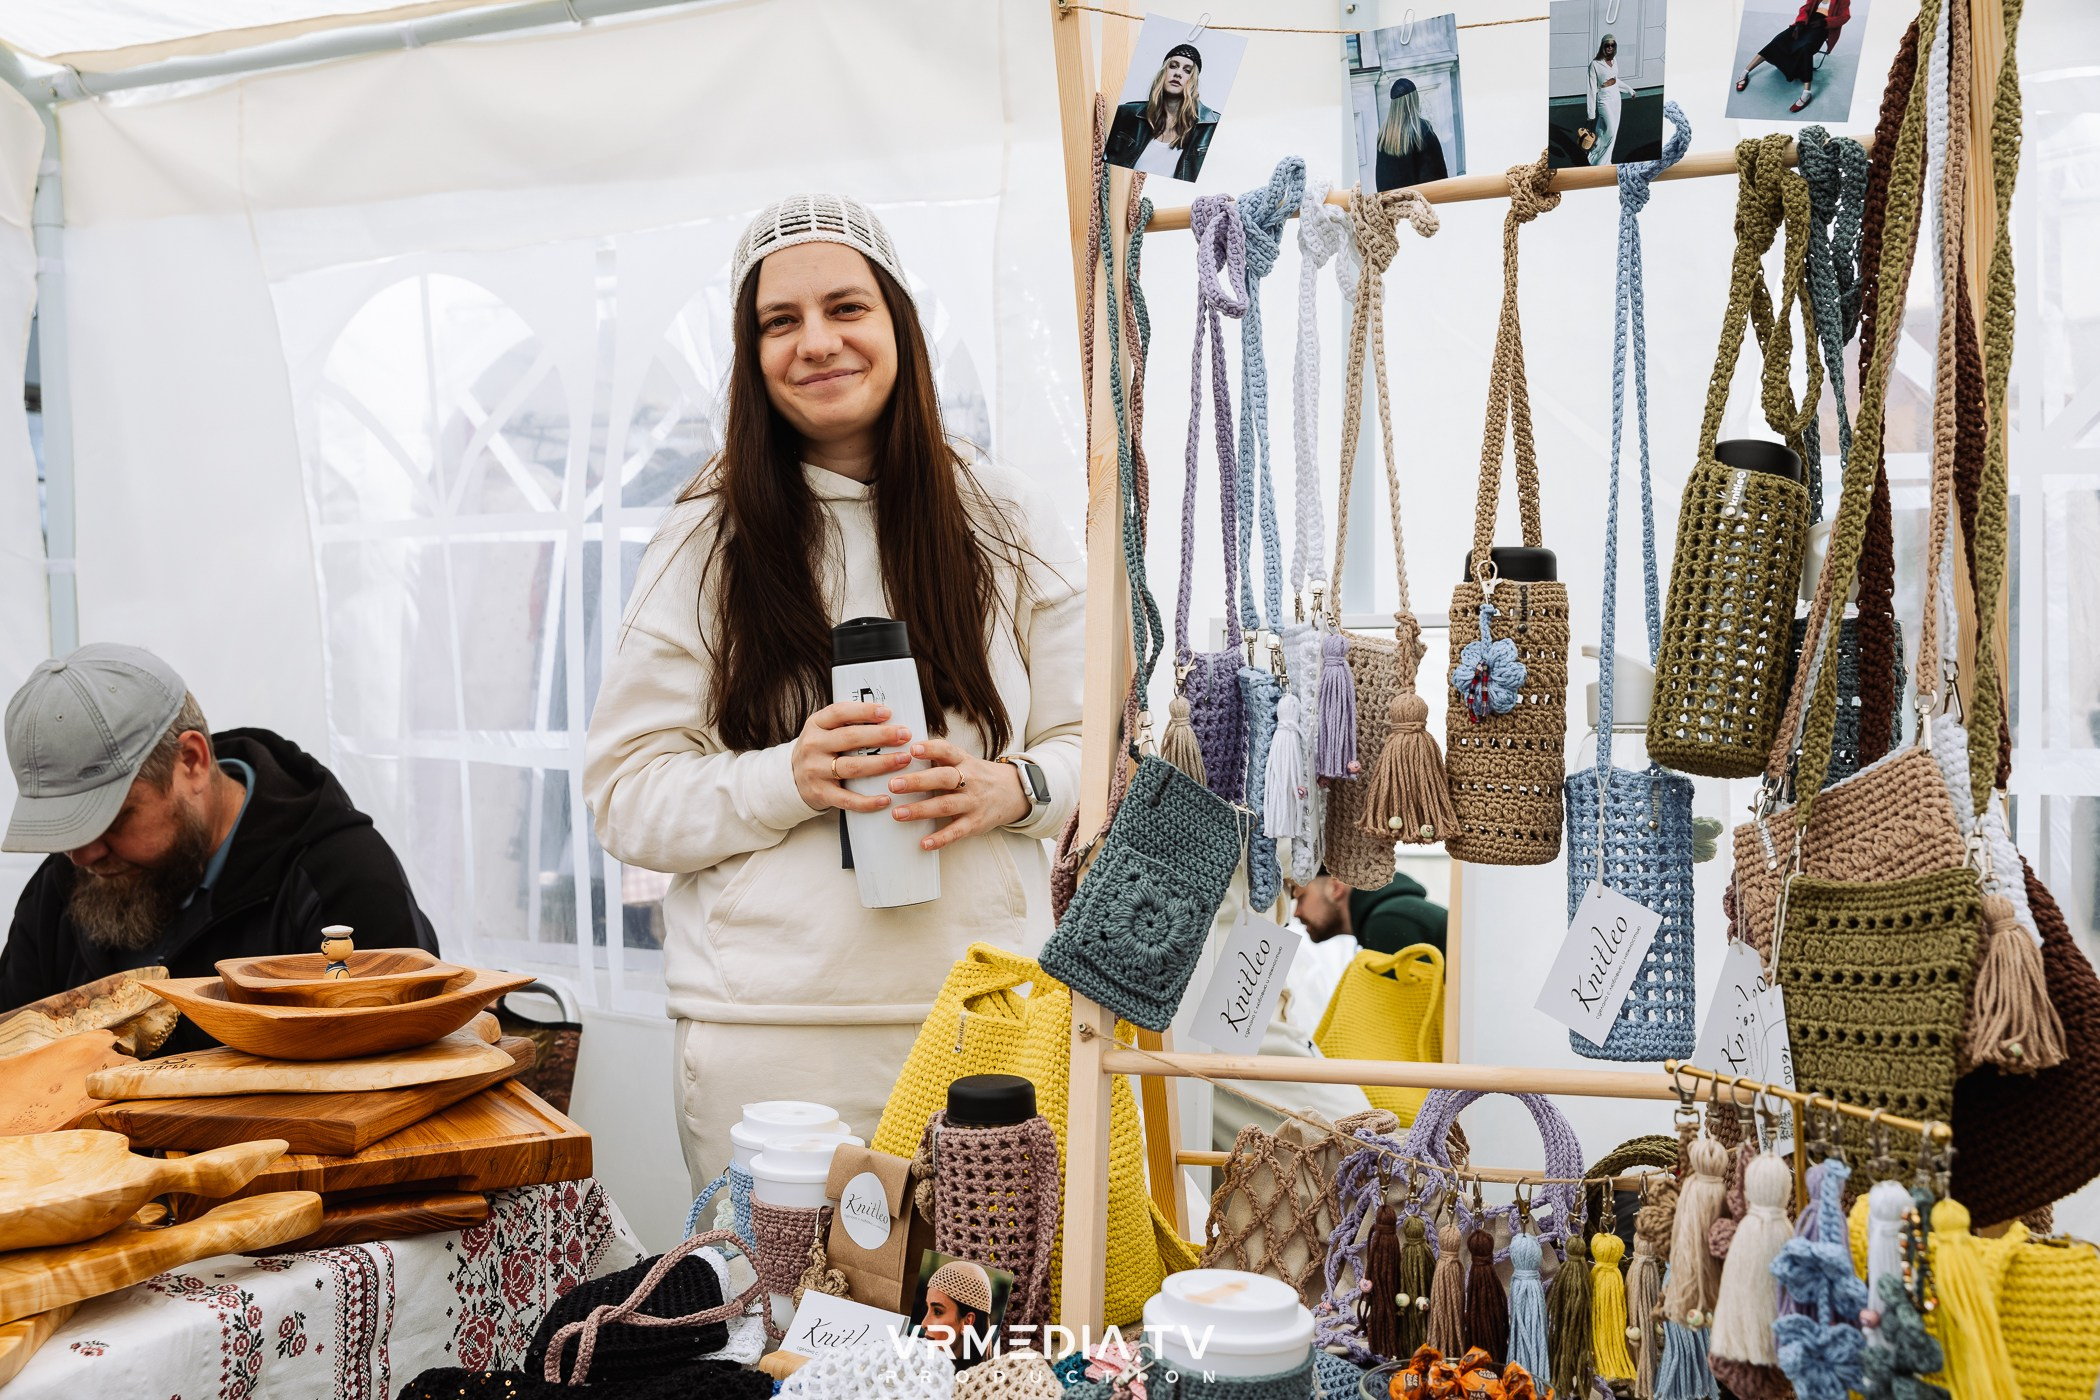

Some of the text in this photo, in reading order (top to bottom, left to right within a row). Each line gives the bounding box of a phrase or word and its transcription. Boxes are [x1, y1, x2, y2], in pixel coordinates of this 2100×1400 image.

[1570, 916, 1628, 1013] Knitleo
[1219, 939, 1271, 1033] Knitleo
[1596, 995, 1609, 1020] сделано
[1244, 1014, 1256, 1038] сделано
[1781, 1046, 1794, 1085] 1600
[845, 1193, 889, 1224] Knitleo
[802, 1317, 884, 1349] Knitl
